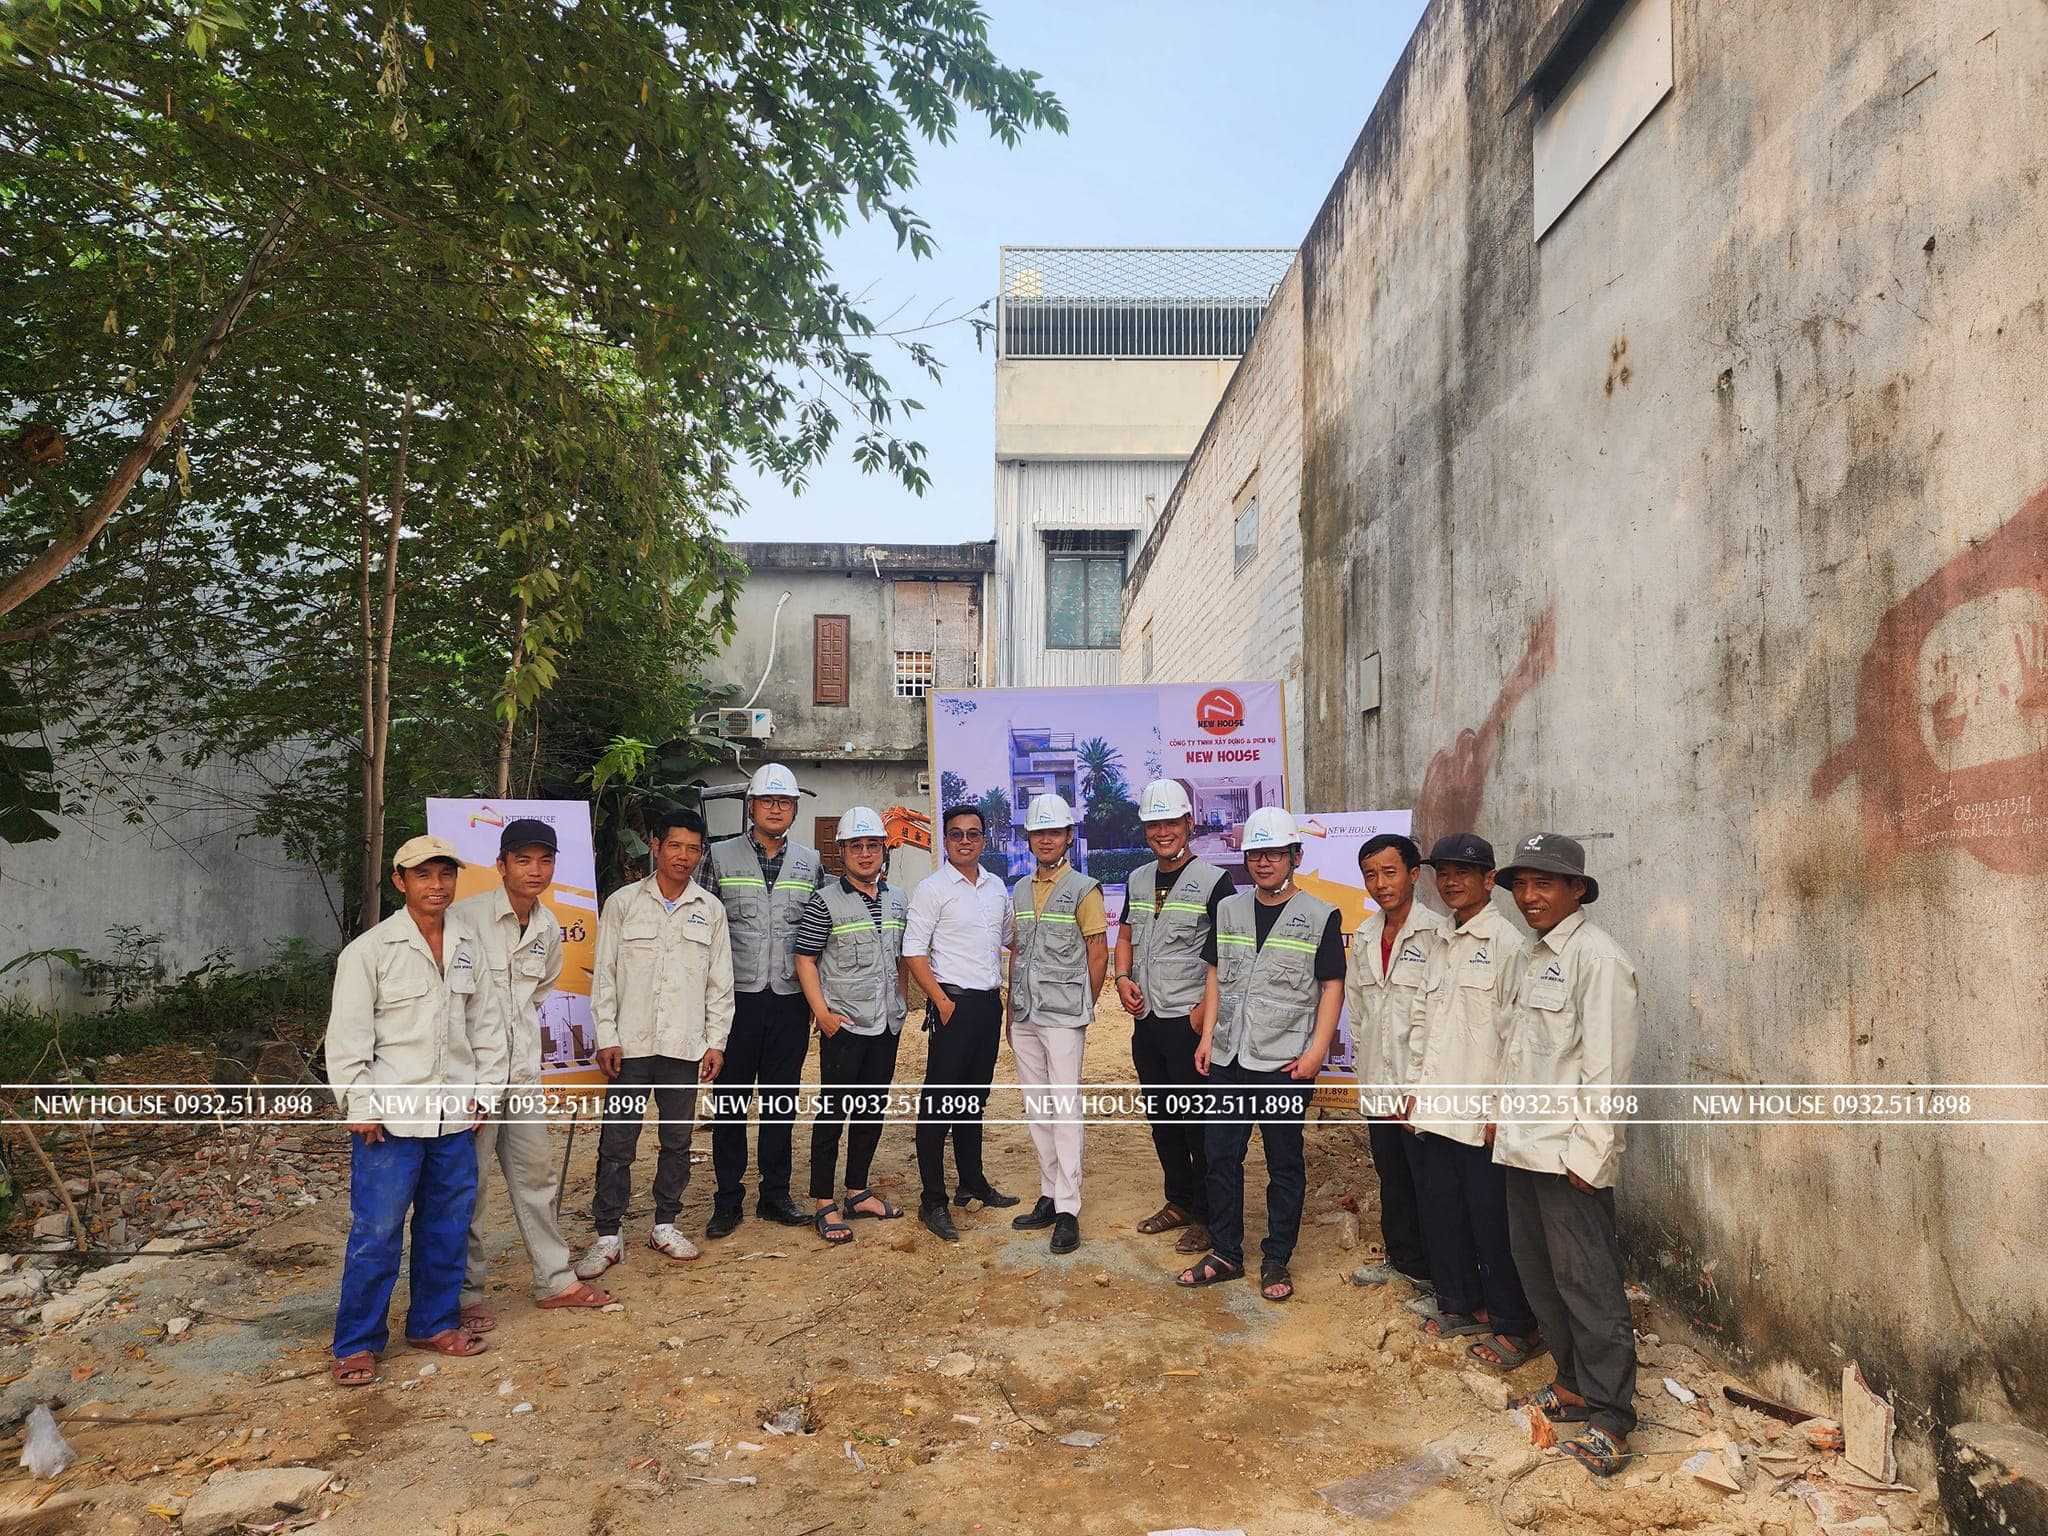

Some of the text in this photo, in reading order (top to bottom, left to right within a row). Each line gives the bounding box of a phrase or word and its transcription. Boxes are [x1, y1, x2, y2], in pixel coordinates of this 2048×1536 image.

[1197, 719, 1245, 728] NEW HOUSE
[1186, 749, 1260, 763] NEW HOUSE
[1327, 825, 1378, 834] NEW HOUSE
